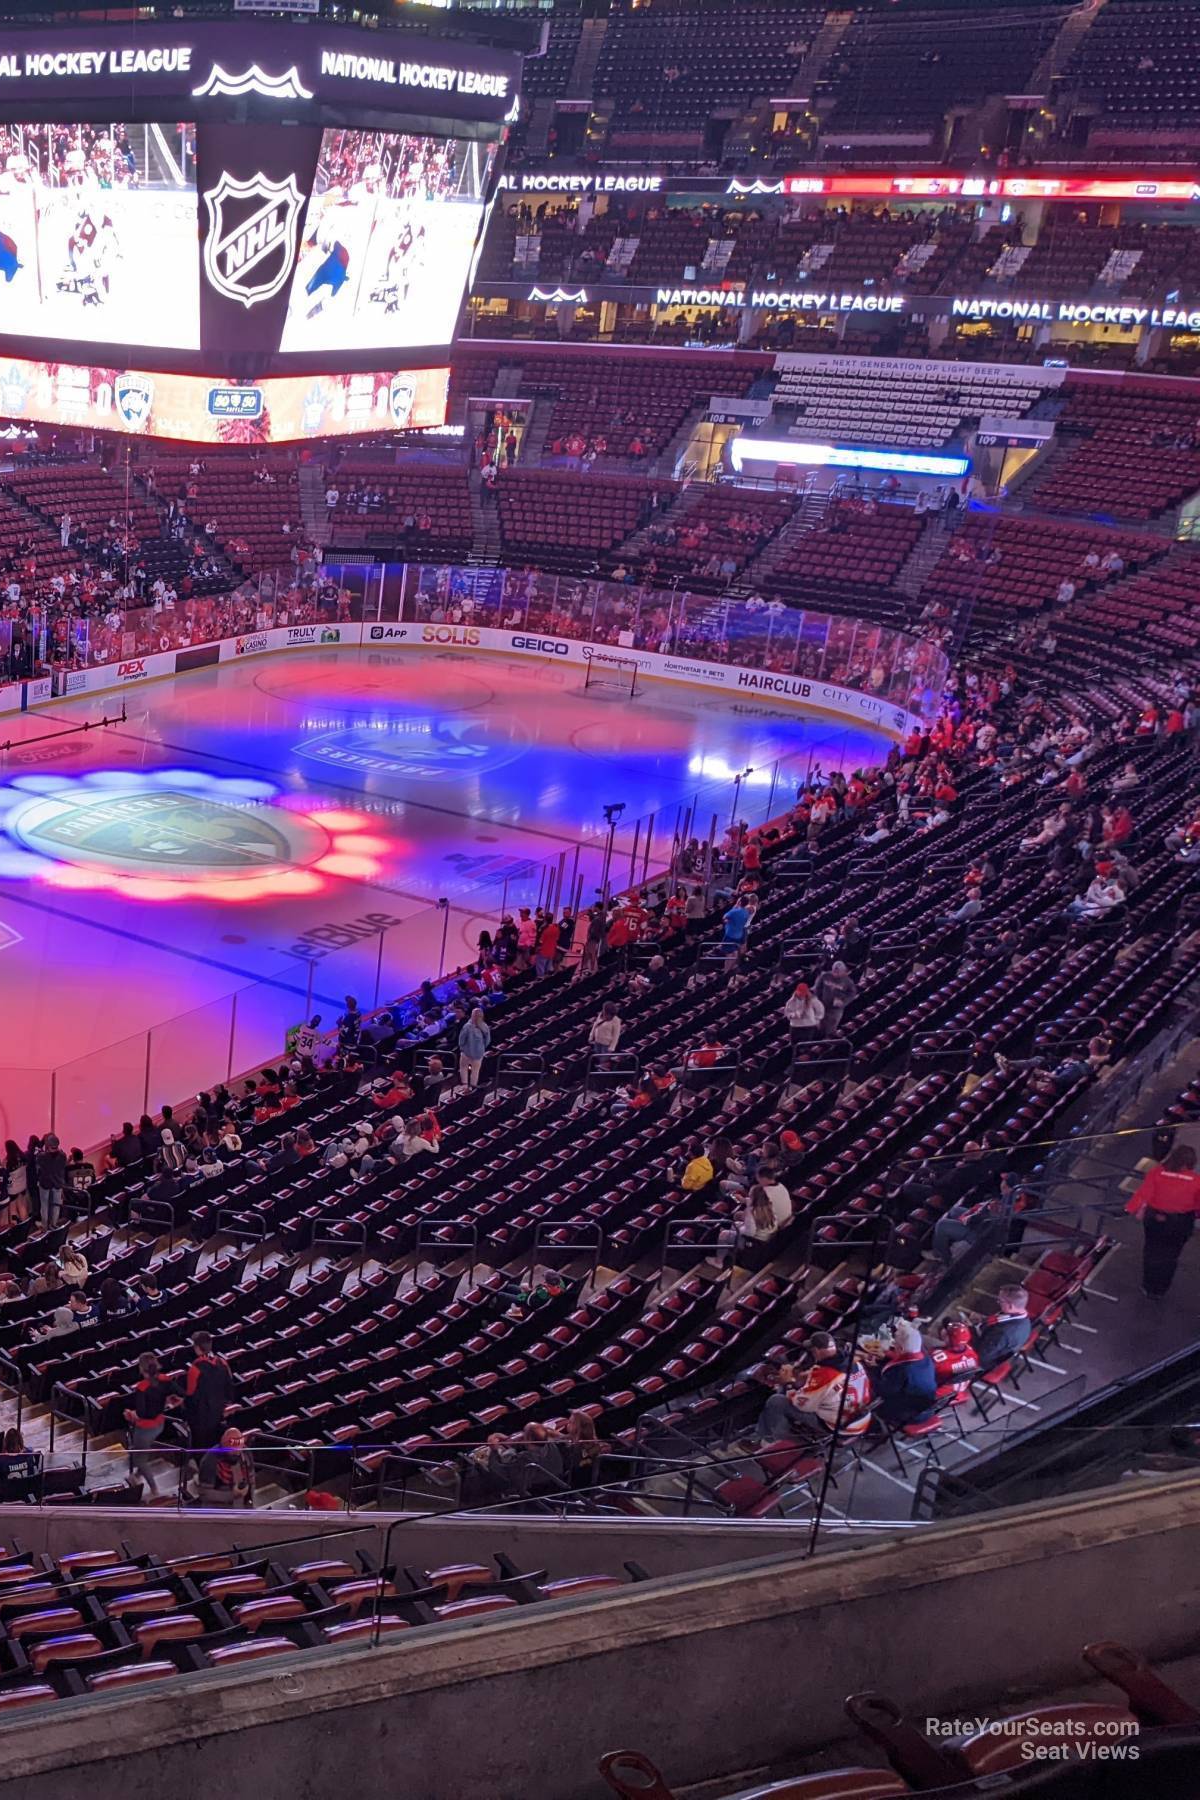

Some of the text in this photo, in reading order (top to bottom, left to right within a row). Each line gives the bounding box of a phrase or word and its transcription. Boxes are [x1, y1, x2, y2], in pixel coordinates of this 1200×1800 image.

[25, 51, 104, 75] HOCKEY
[110, 48, 191, 72] LEAGUE
[321, 52, 508, 97] NATIONAL HOCKEY LEAGUE
[521, 176, 591, 193] HOCKEY
[595, 177, 661, 193] LEAGUE
[225, 209, 285, 278] NHL
[657, 289, 903, 313] NATIONAL HOCKEY LEAGUE
[953, 298, 1052, 320] NATIONAL
[1058, 303, 1146, 325] HOCKEY
[832, 358, 1001, 376] NEXT GENERATION OF LIGHT BEER
[977, 434, 997, 446] 109
[288, 626, 317, 638] TRULY
[422, 625, 481, 646] SOLIS
[245, 639, 268, 650] CASINO
[511, 636, 569, 656] GEICO
[117, 659, 146, 677] DEX
[738, 672, 812, 698] HAIRCLUB
[822, 687, 851, 702] CITY
[859, 698, 884, 713] CITY
[315, 745, 449, 776] PANTHERS
[53, 796, 181, 838] PANTHERS
[270, 912, 403, 967] jetBlue
